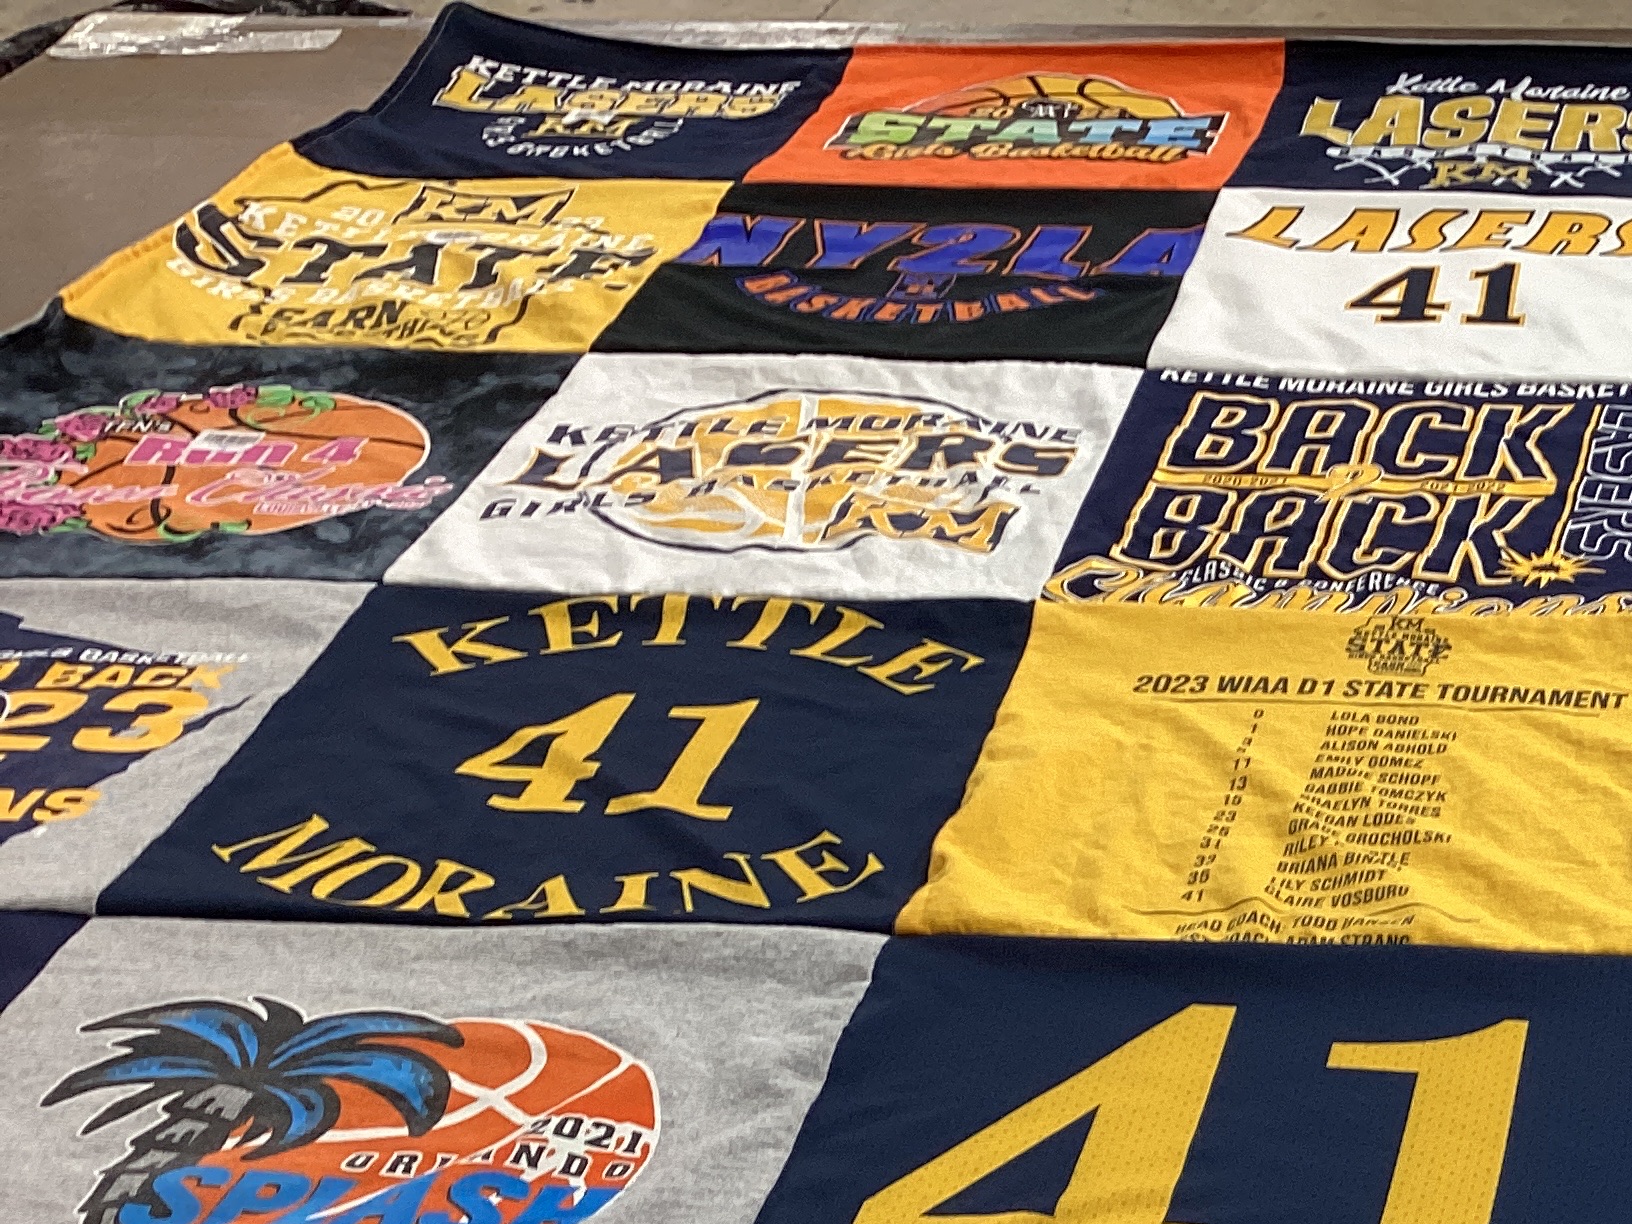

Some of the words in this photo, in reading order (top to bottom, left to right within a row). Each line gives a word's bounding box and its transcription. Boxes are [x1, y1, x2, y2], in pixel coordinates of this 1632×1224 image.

[844, 111, 1212, 147] STATE
[680, 211, 1200, 278] NY2LA
[1343, 261, 1527, 327] 41
[505, 433, 1080, 488] LASERS
[1157, 390, 1577, 485] BACK
[1109, 485, 1548, 585] BACK
[391, 594, 985, 695] KETTLE
[33, 660, 239, 690] BACK
[1132, 673, 1211, 694] 2023
[1216, 675, 1291, 695] WIAA
[1296, 677, 1335, 696] D1
[1342, 678, 1428, 701] STATE
[1436, 682, 1631, 711] TOURNAMENT
[454, 691, 760, 820] 41
[1319, 739, 1380, 752] ALISON
[1325, 723, 1369, 737] HOPE
[1371, 727, 1458, 743] DANIELSKI
[211, 813, 886, 921] MORAINE
[524, 1116, 644, 1155] 2021
